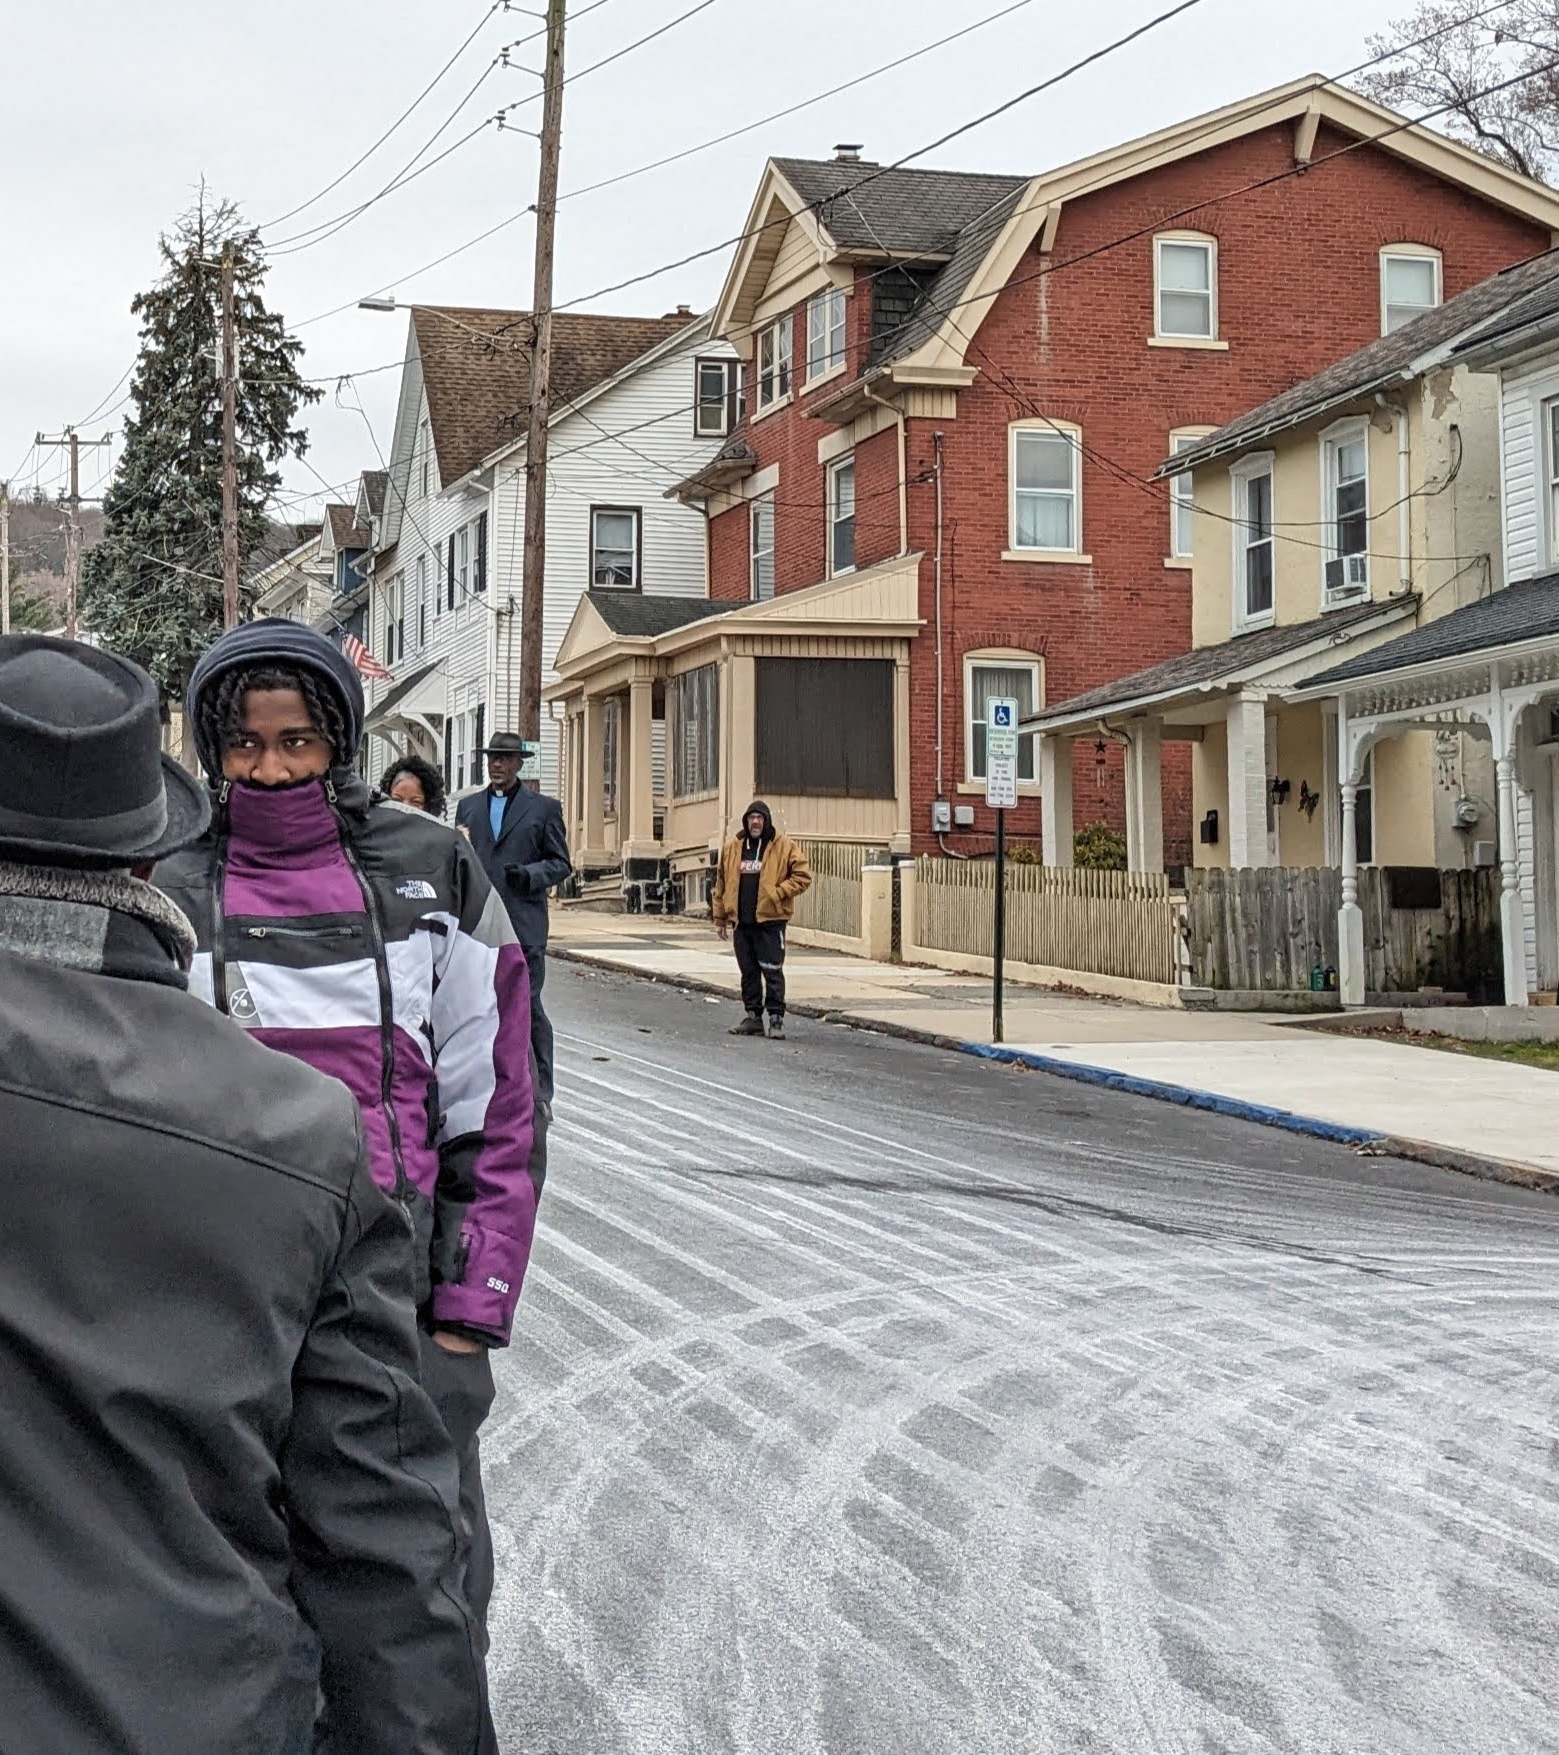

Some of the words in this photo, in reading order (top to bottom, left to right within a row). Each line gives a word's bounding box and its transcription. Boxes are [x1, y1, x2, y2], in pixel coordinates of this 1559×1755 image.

[405, 879, 423, 888] THE
[395, 886, 423, 895] NORTH
[404, 891, 424, 899] FACE
